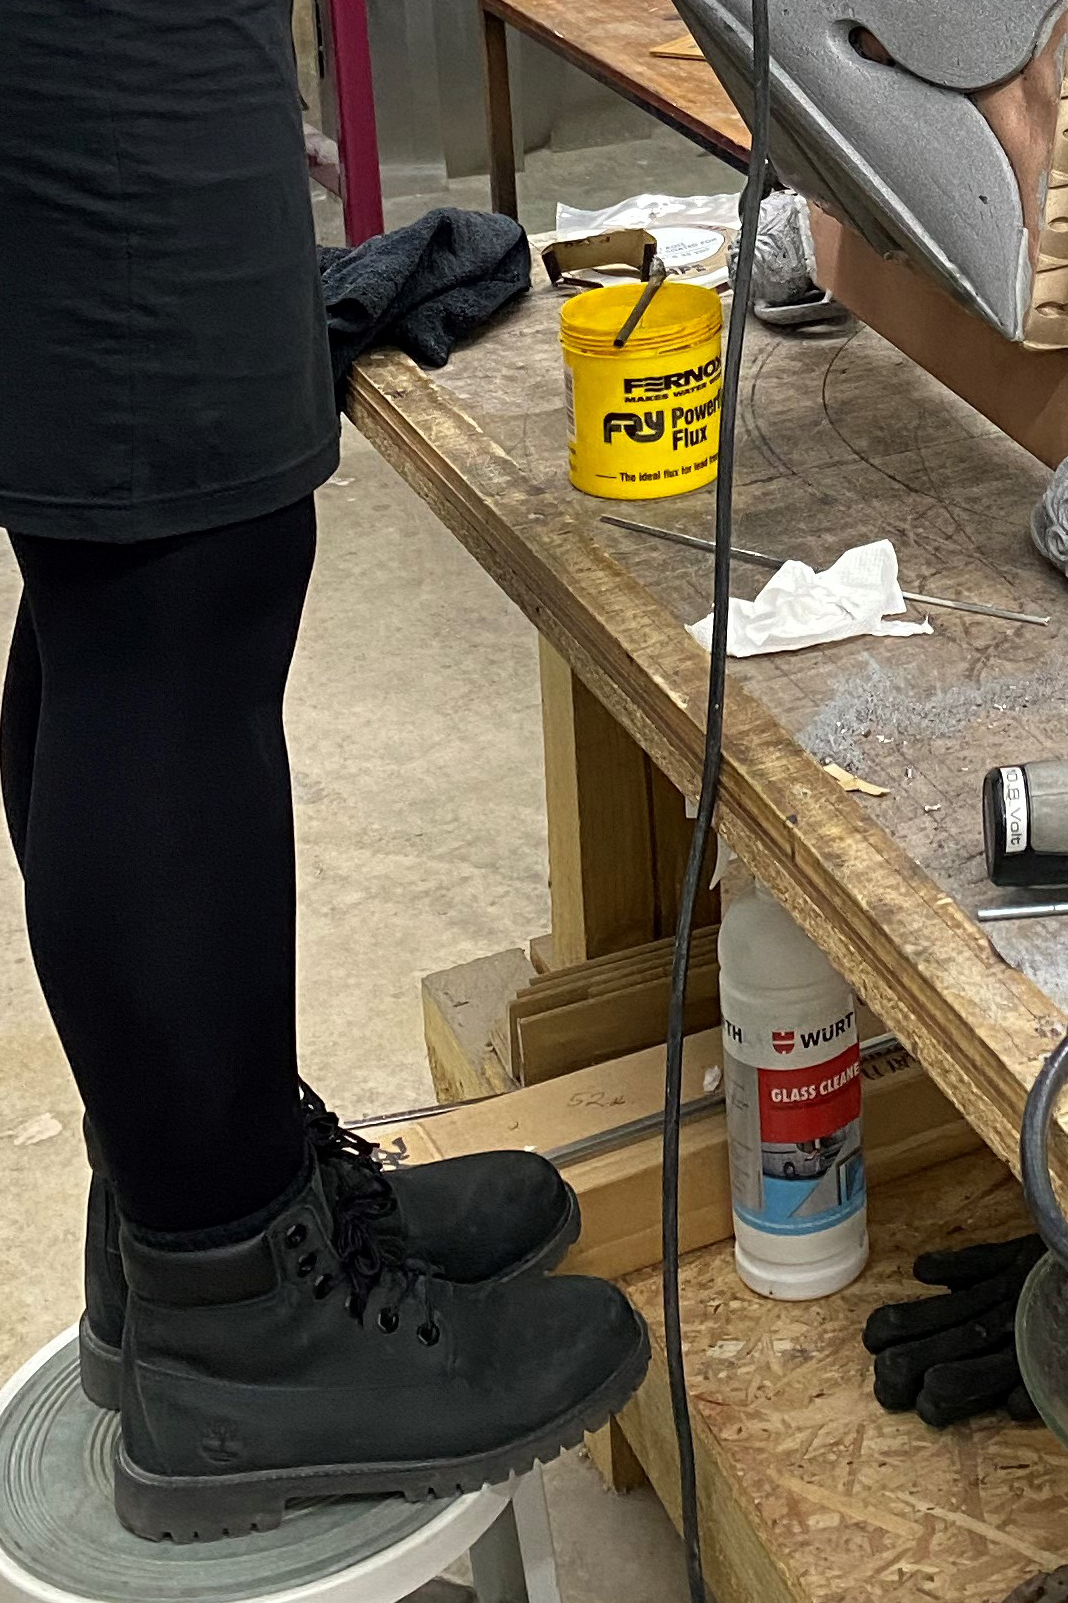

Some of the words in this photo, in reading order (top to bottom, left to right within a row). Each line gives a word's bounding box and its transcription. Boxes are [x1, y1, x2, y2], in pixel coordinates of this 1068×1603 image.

[624, 393, 669, 403] MAKES
[673, 382, 707, 397] WATER
[672, 424, 708, 451] Flux
[619, 472, 636, 482] The
[639, 471, 661, 482] ideal
[663, 469, 679, 479] flux
[681, 465, 692, 475] for
[1010, 807, 1022, 846] Volt
[800, 1011, 854, 1049] WÜRT
[771, 1084, 817, 1103] GLASS
